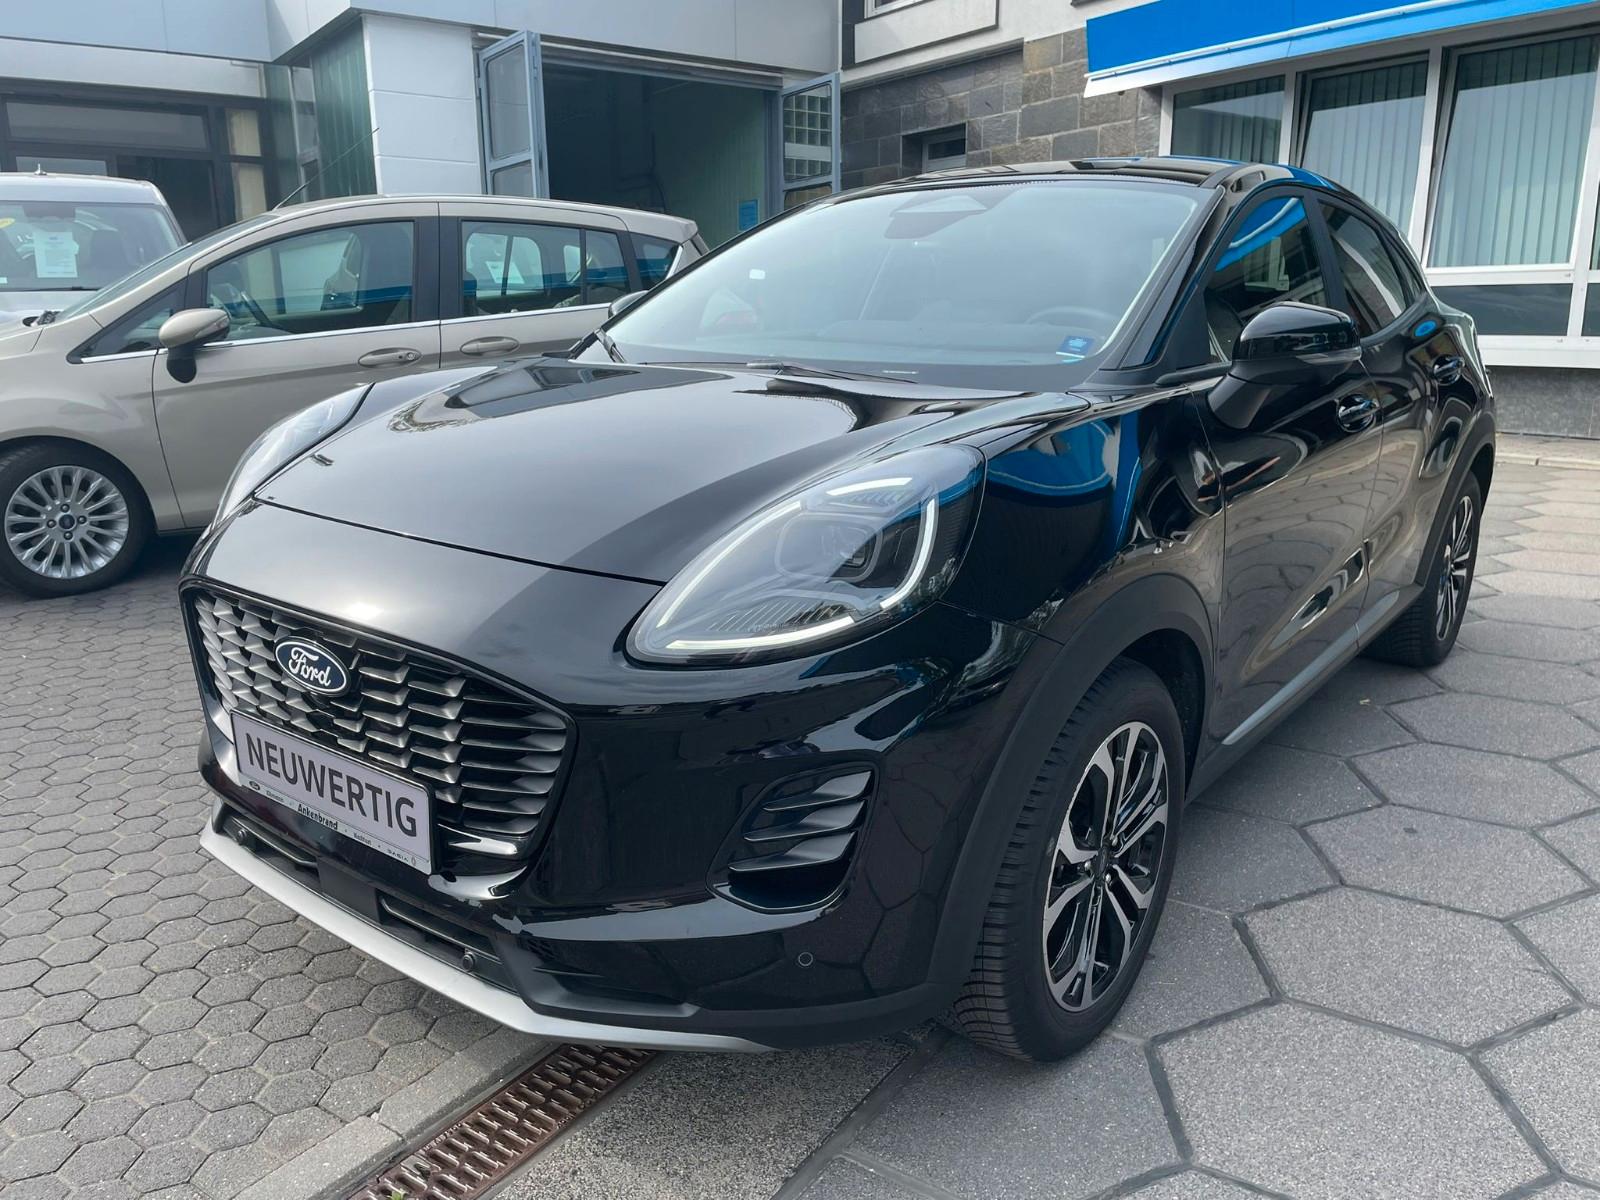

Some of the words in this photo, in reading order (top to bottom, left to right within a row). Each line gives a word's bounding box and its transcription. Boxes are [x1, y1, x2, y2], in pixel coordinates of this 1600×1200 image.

[288, 647, 331, 687] Ford
[246, 733, 417, 837] NEUWERTIG
[298, 803, 338, 830] Ankenbrand
